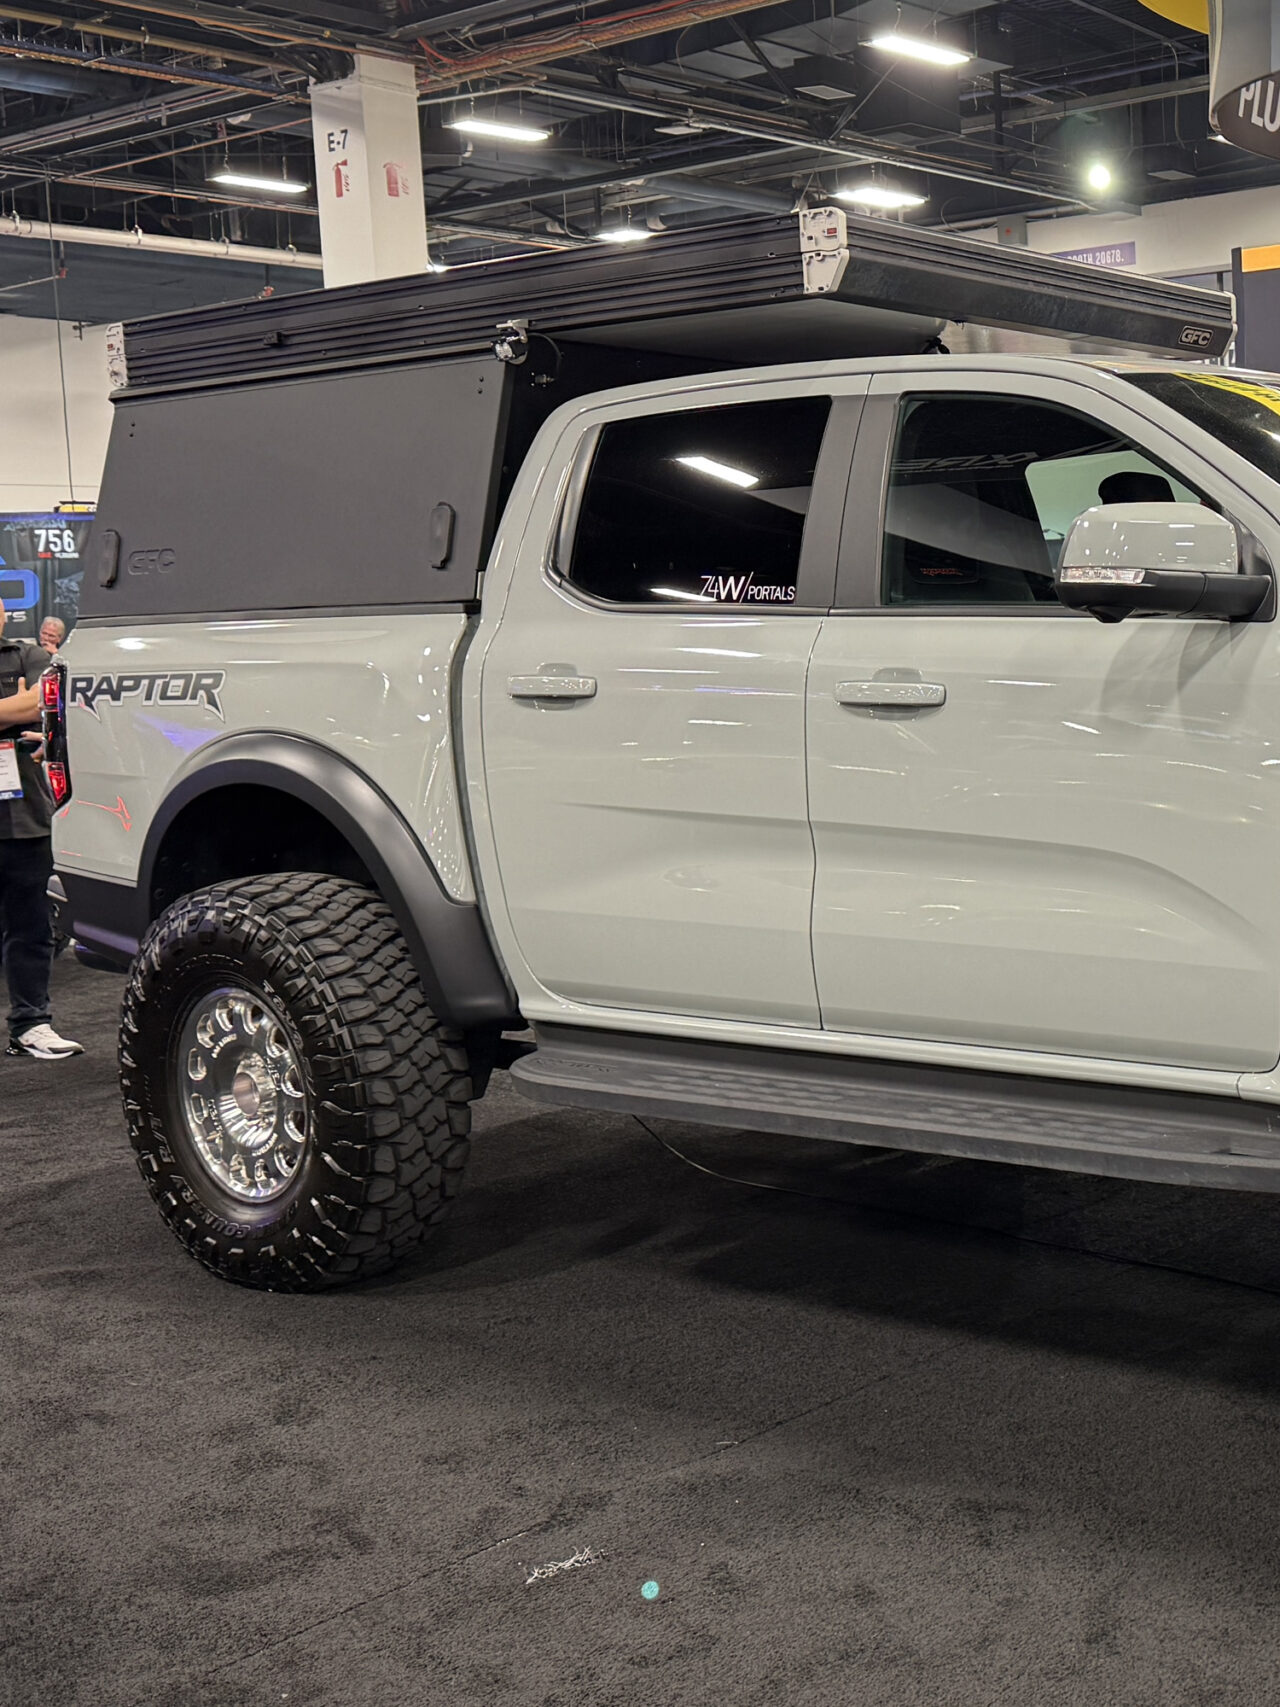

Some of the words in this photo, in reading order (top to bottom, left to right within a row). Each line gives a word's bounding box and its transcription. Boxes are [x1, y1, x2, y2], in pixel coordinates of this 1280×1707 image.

[1181, 330, 1211, 346] GFC
[34, 529, 75, 553] 756
[128, 548, 176, 575] GFC
[69, 670, 226, 722] RAPTOR
